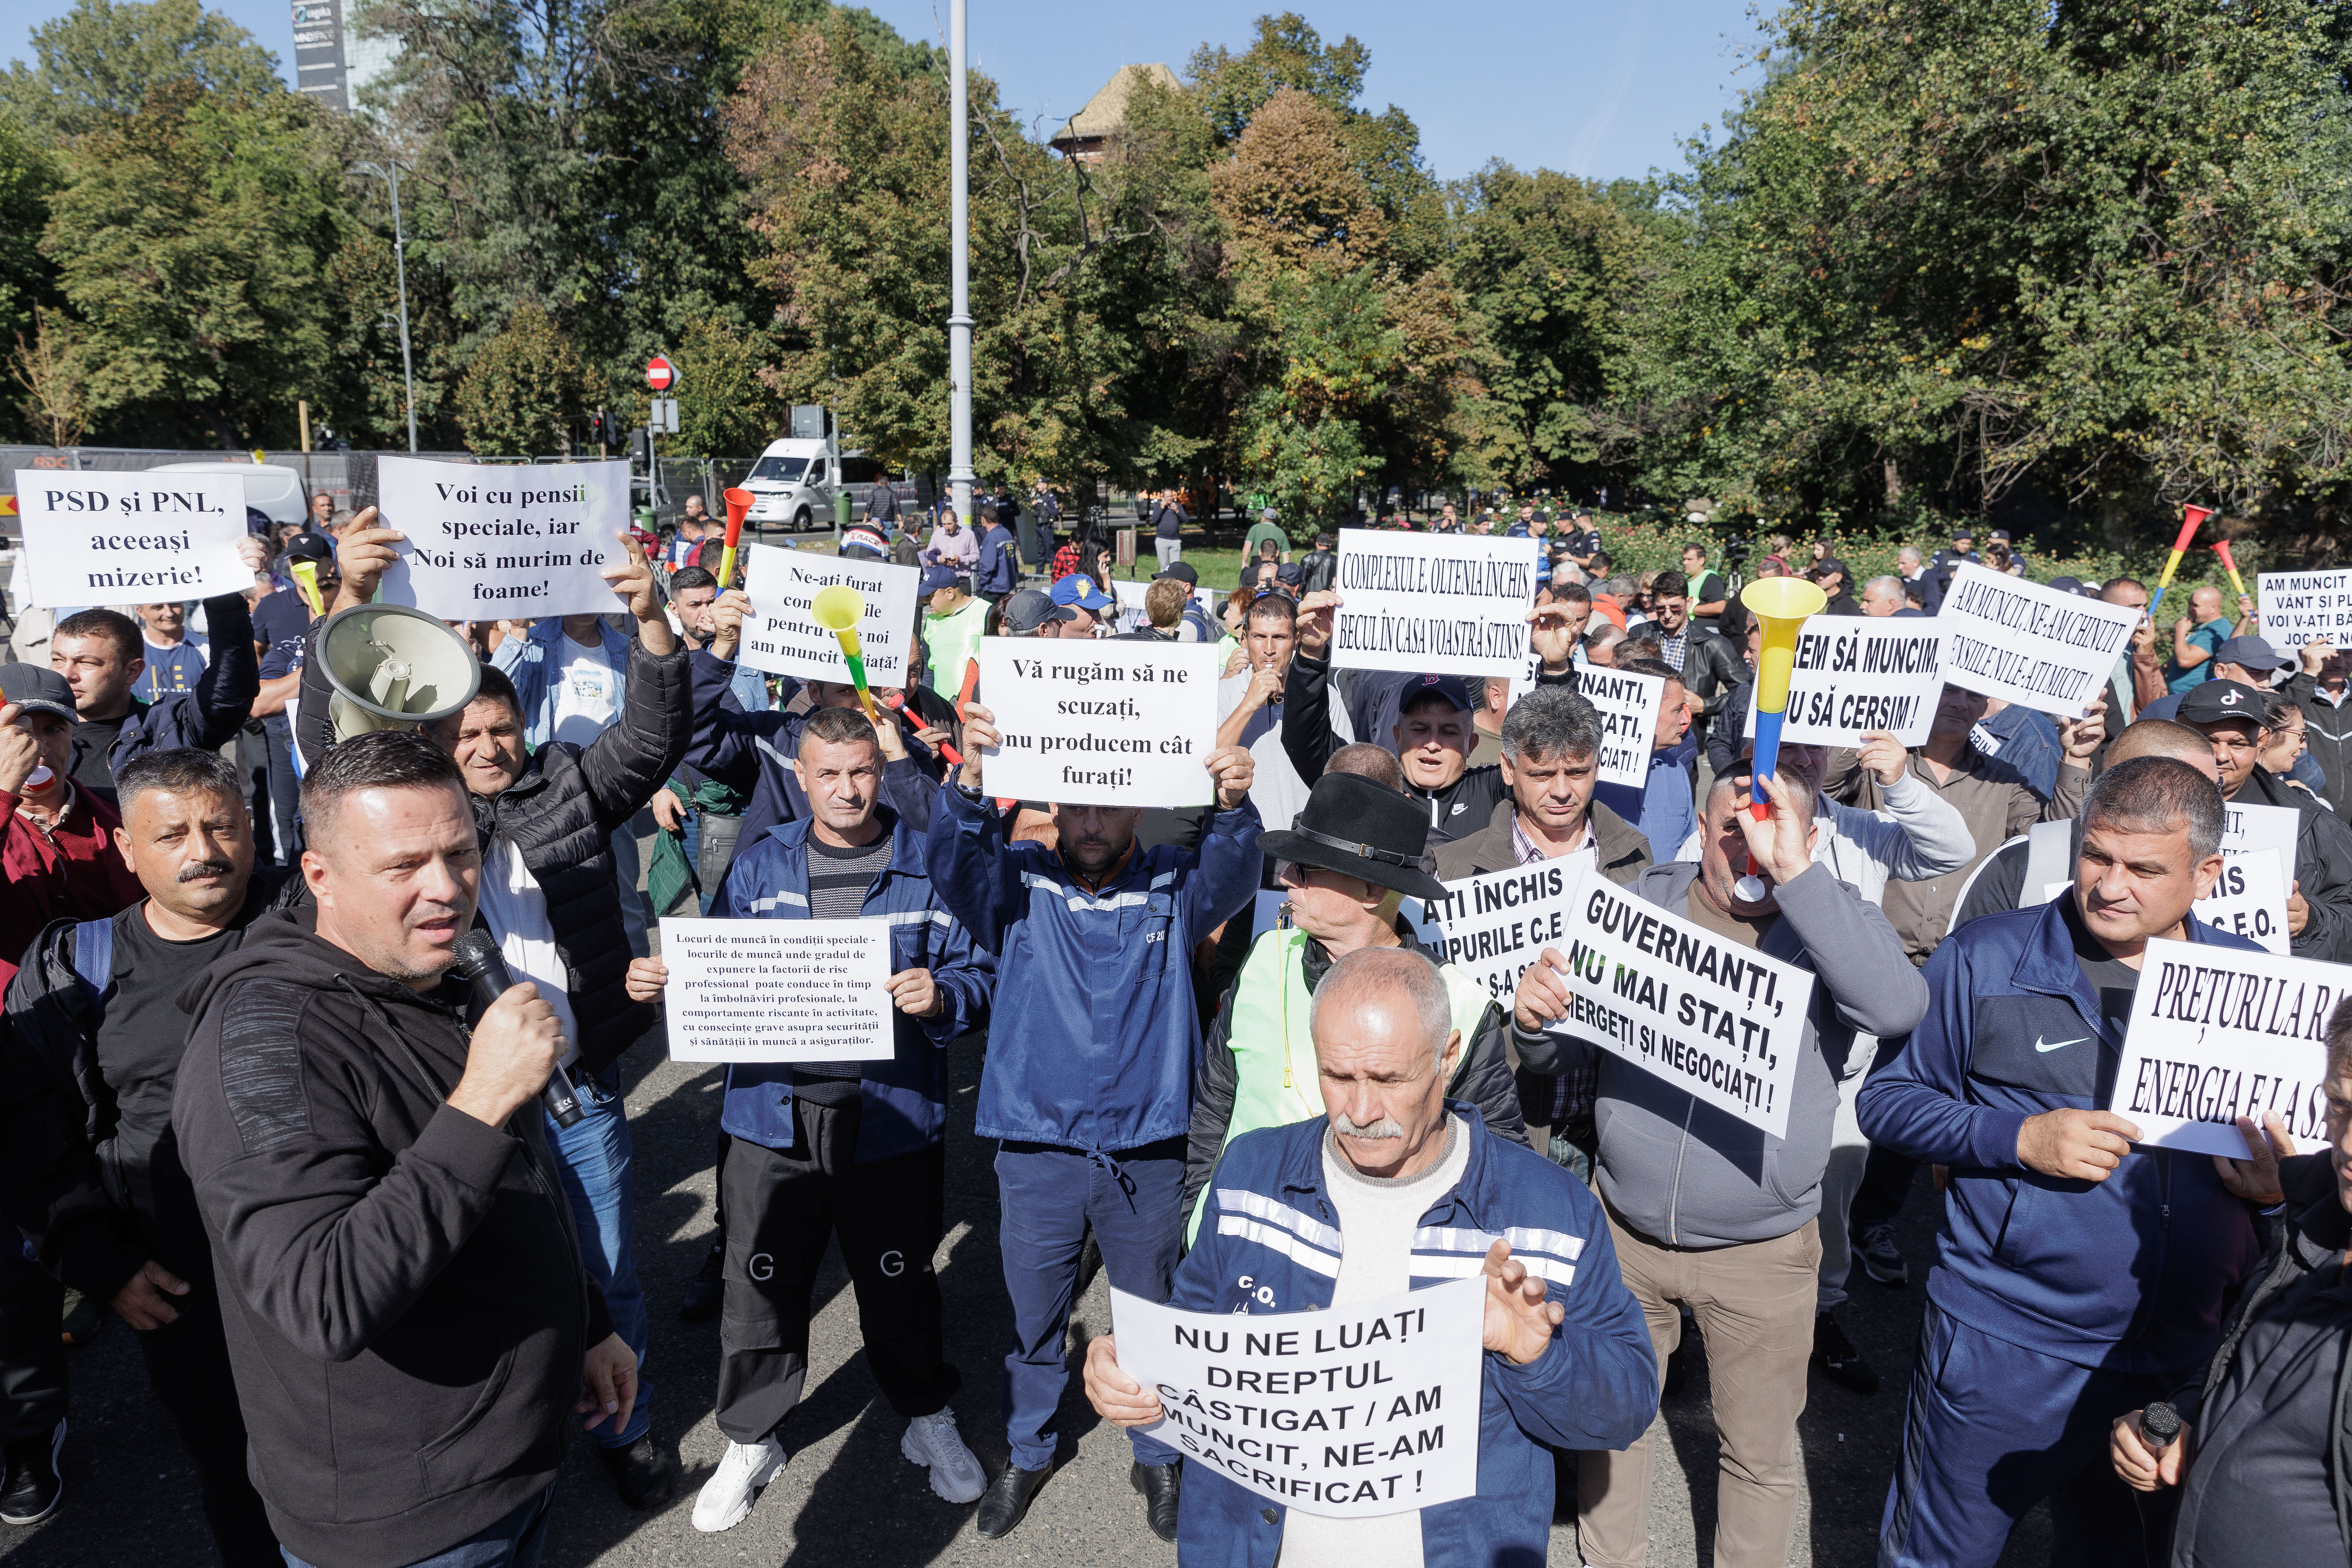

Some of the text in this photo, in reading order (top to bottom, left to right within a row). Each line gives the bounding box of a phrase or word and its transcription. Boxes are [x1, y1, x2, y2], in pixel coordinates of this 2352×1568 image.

[44, 491, 224, 516] PSD și PNL,
[435, 483, 585, 508] Voi cu pensii
[443, 518, 579, 539] speciale, iar
[92, 530, 190, 553] aceeași
[412, 548, 604, 568] Noi să murim de
[87, 567, 202, 587] mizerie!
[845, 576, 883, 593] furat
[1343, 553, 1529, 606] COMPLEXUL E. OLTENIA ÎNCHIS,
[2266, 576, 2346, 591] AM MUNCIT
[473, 580, 548, 599] foame!
[2276, 594, 2313, 609] VÂNT
[2319, 595, 2331, 612] ȘI
[1952, 579, 2128, 653] AM MUNCIT, NE-AM CHINUIT
[2267, 615, 2288, 627] VOI
[2294, 614, 2330, 631] V-AȚI
[767, 617, 823, 637] pentru
[867, 631, 889, 644] noi
[1339, 608, 1524, 659] BECUL ÎN CASA VOASTRĂ STINS!
[2285, 633, 2310, 645] JOC
[751, 641, 774, 653] am
[781, 646, 839, 664] muncit
[1832, 627, 1860, 672] SĂ
[1862, 637, 1939, 681] MUNCIM,
[1012, 660, 1187, 685] Vă rugăm să ne
[1058, 698, 1139, 721] scuzați,
[1808, 684, 1836, 727] SĂ
[1909, 695, 1920, 729] !
[1005, 733, 1192, 754] nu producem cât
[1063, 766, 1131, 790] furați!
[1472, 868, 1563, 914] ÎNCHIS
[677, 934, 711, 943] Locuri
[784, 936, 823, 946] condiții
[827, 936, 868, 946] speciale
[1146, 933, 1155, 943] CE
[688, 950, 727, 958] locurile
[815, 951, 849, 961] gradul
[1587, 889, 1784, 1019] GUVERNANȚI,
[685, 980, 748, 989] professional
[756, 981, 784, 990] poate
[847, 980, 870, 989] timp
[713, 994, 774, 1002] îmbolnăviri
[778, 995, 845, 1004] profesionale,
[1569, 939, 1607, 985] NU
[1613, 962, 1669, 1016] MAI
[1677, 992, 1778, 1072] STAȚI,
[2151, 962, 2273, 1044] PREȚURI
[2264, 979, 2306, 1038] LA
[683, 1010, 765, 1019] comportamente
[698, 1024, 751, 1033] consecințe
[827, 1022, 878, 1031] securității
[690, 1038, 697, 1047] și
[701, 1038, 745, 1047] sănătății
[810, 1037, 873, 1047] asiguraților.
[1639, 1024, 1656, 1063] ȘI
[1661, 1034, 1764, 1114] NEGOCIAȚI
[1766, 1084, 1774, 1114] !
[2128, 1057, 2242, 1126] ENERGIA
[749, 1253, 774, 1281] G
[880, 1250, 904, 1277] G
[1176, 1308, 1424, 1356] NU NE LUAȚI
[1208, 1360, 1392, 1394] DREPTUL
[1156, 1382, 1442, 1433] CÂSTIGAT / AM
[1161, 1404, 1444, 1471] MUNCIT, NE-AM
[1180, 1433, 1423, 1505] SACRIFICAT !
